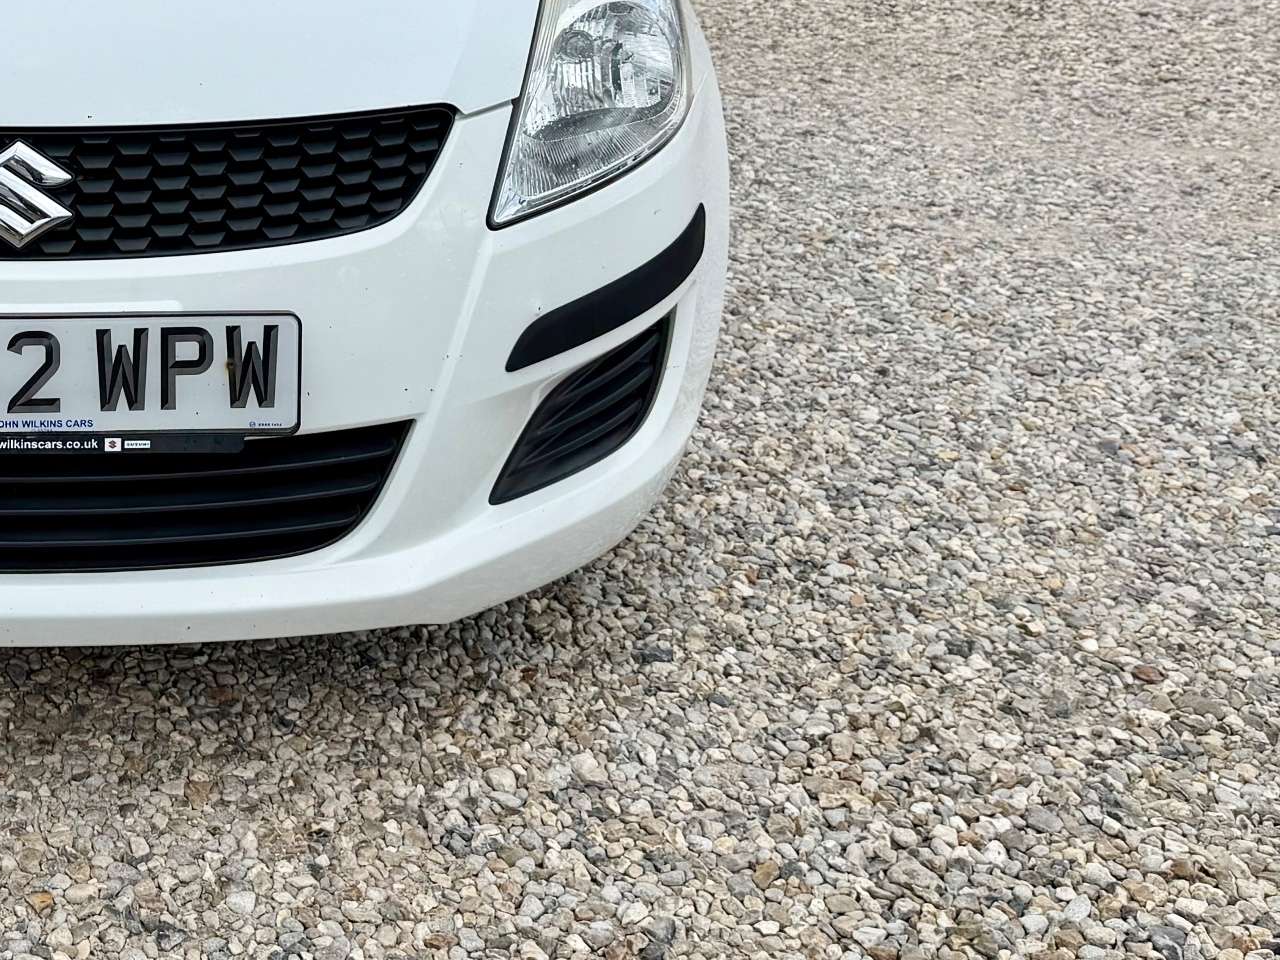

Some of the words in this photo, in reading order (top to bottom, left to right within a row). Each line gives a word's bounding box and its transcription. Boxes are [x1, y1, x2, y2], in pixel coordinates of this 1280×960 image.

[95, 324, 280, 412] WPW
[21, 419, 63, 429] WILKINS
[65, 419, 94, 428] CARS
